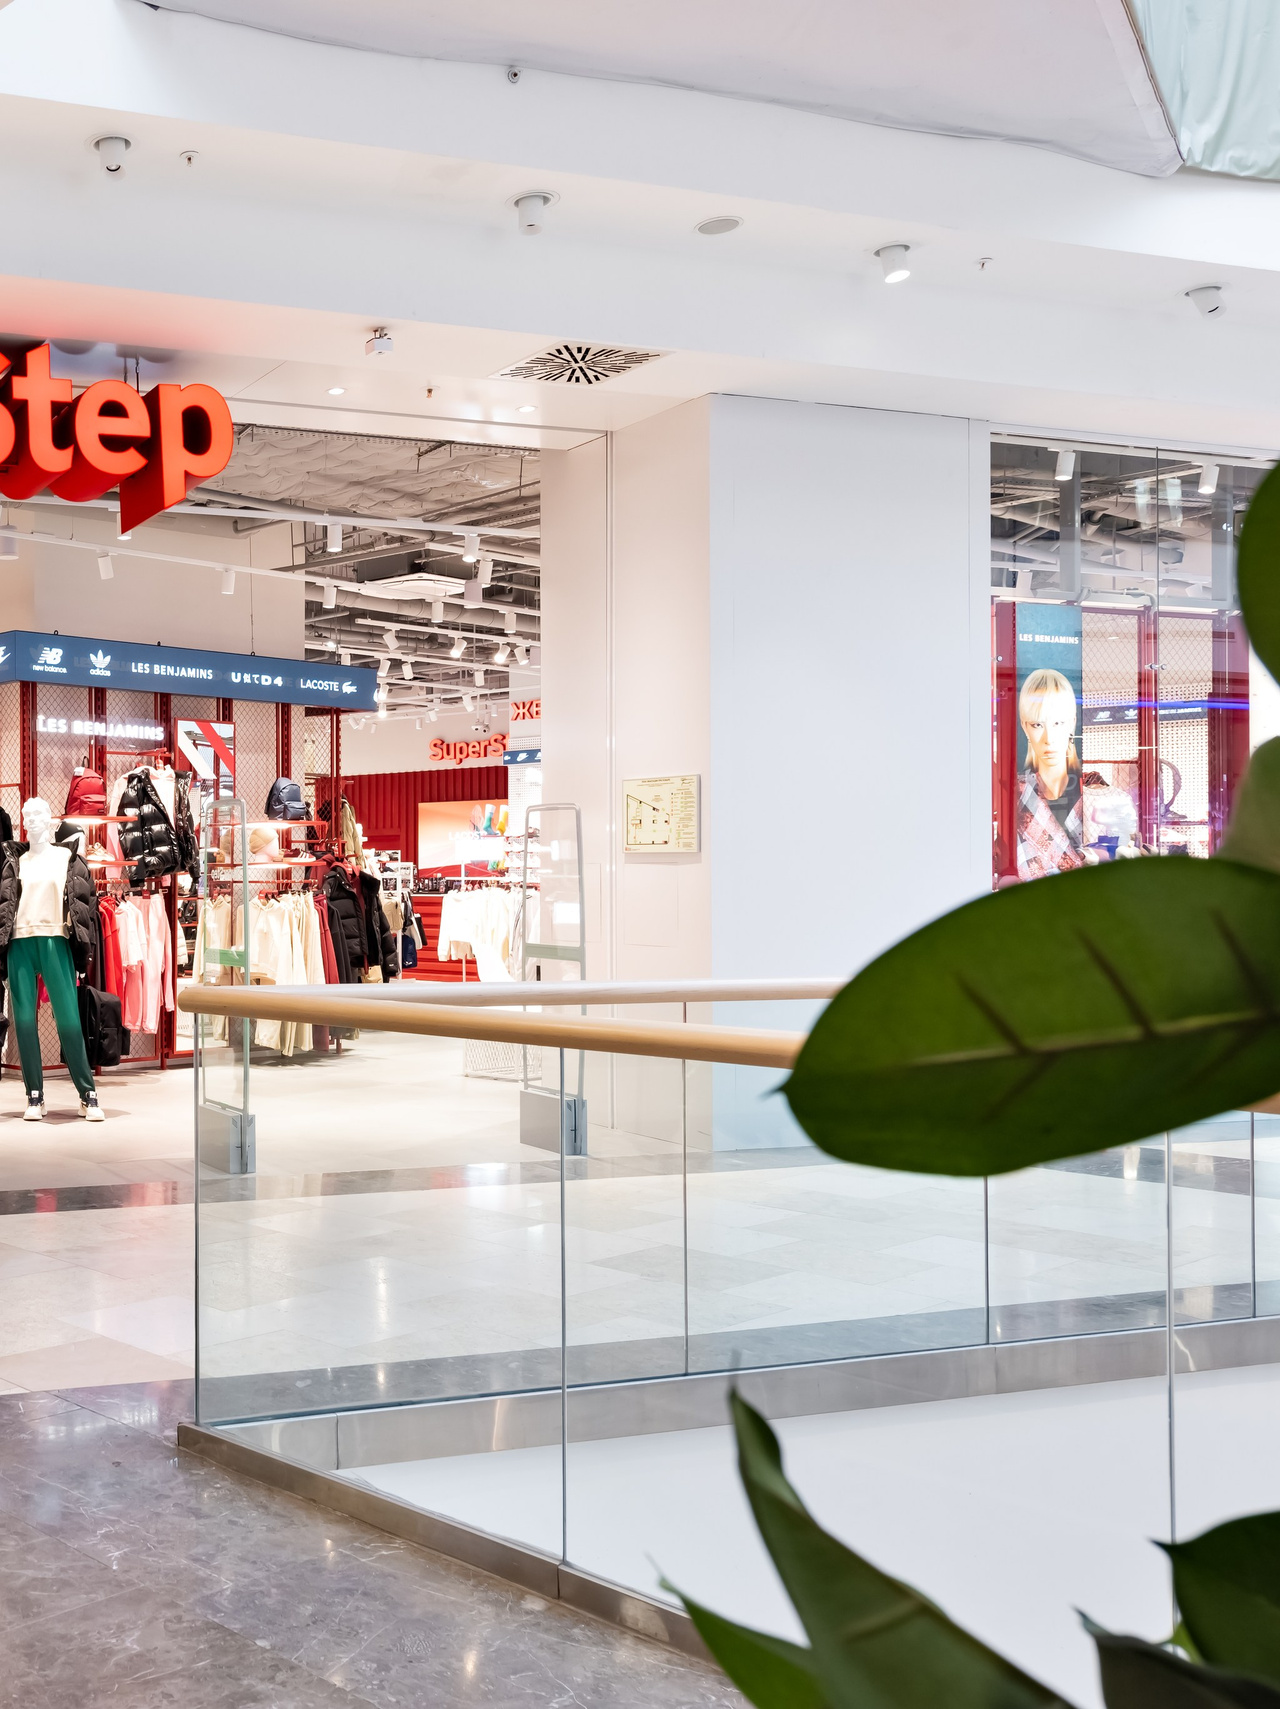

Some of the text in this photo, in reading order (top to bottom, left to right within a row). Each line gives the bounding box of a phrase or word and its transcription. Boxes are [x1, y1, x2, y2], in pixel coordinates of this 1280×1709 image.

[1019, 633, 1079, 645] LES BENJAMINS
[89, 668, 111, 677] adidas
[131, 662, 213, 680] LES BENJAMINS
[300, 678, 340, 692] LACOSTE
[36, 716, 165, 741] LES BENJAMINS
